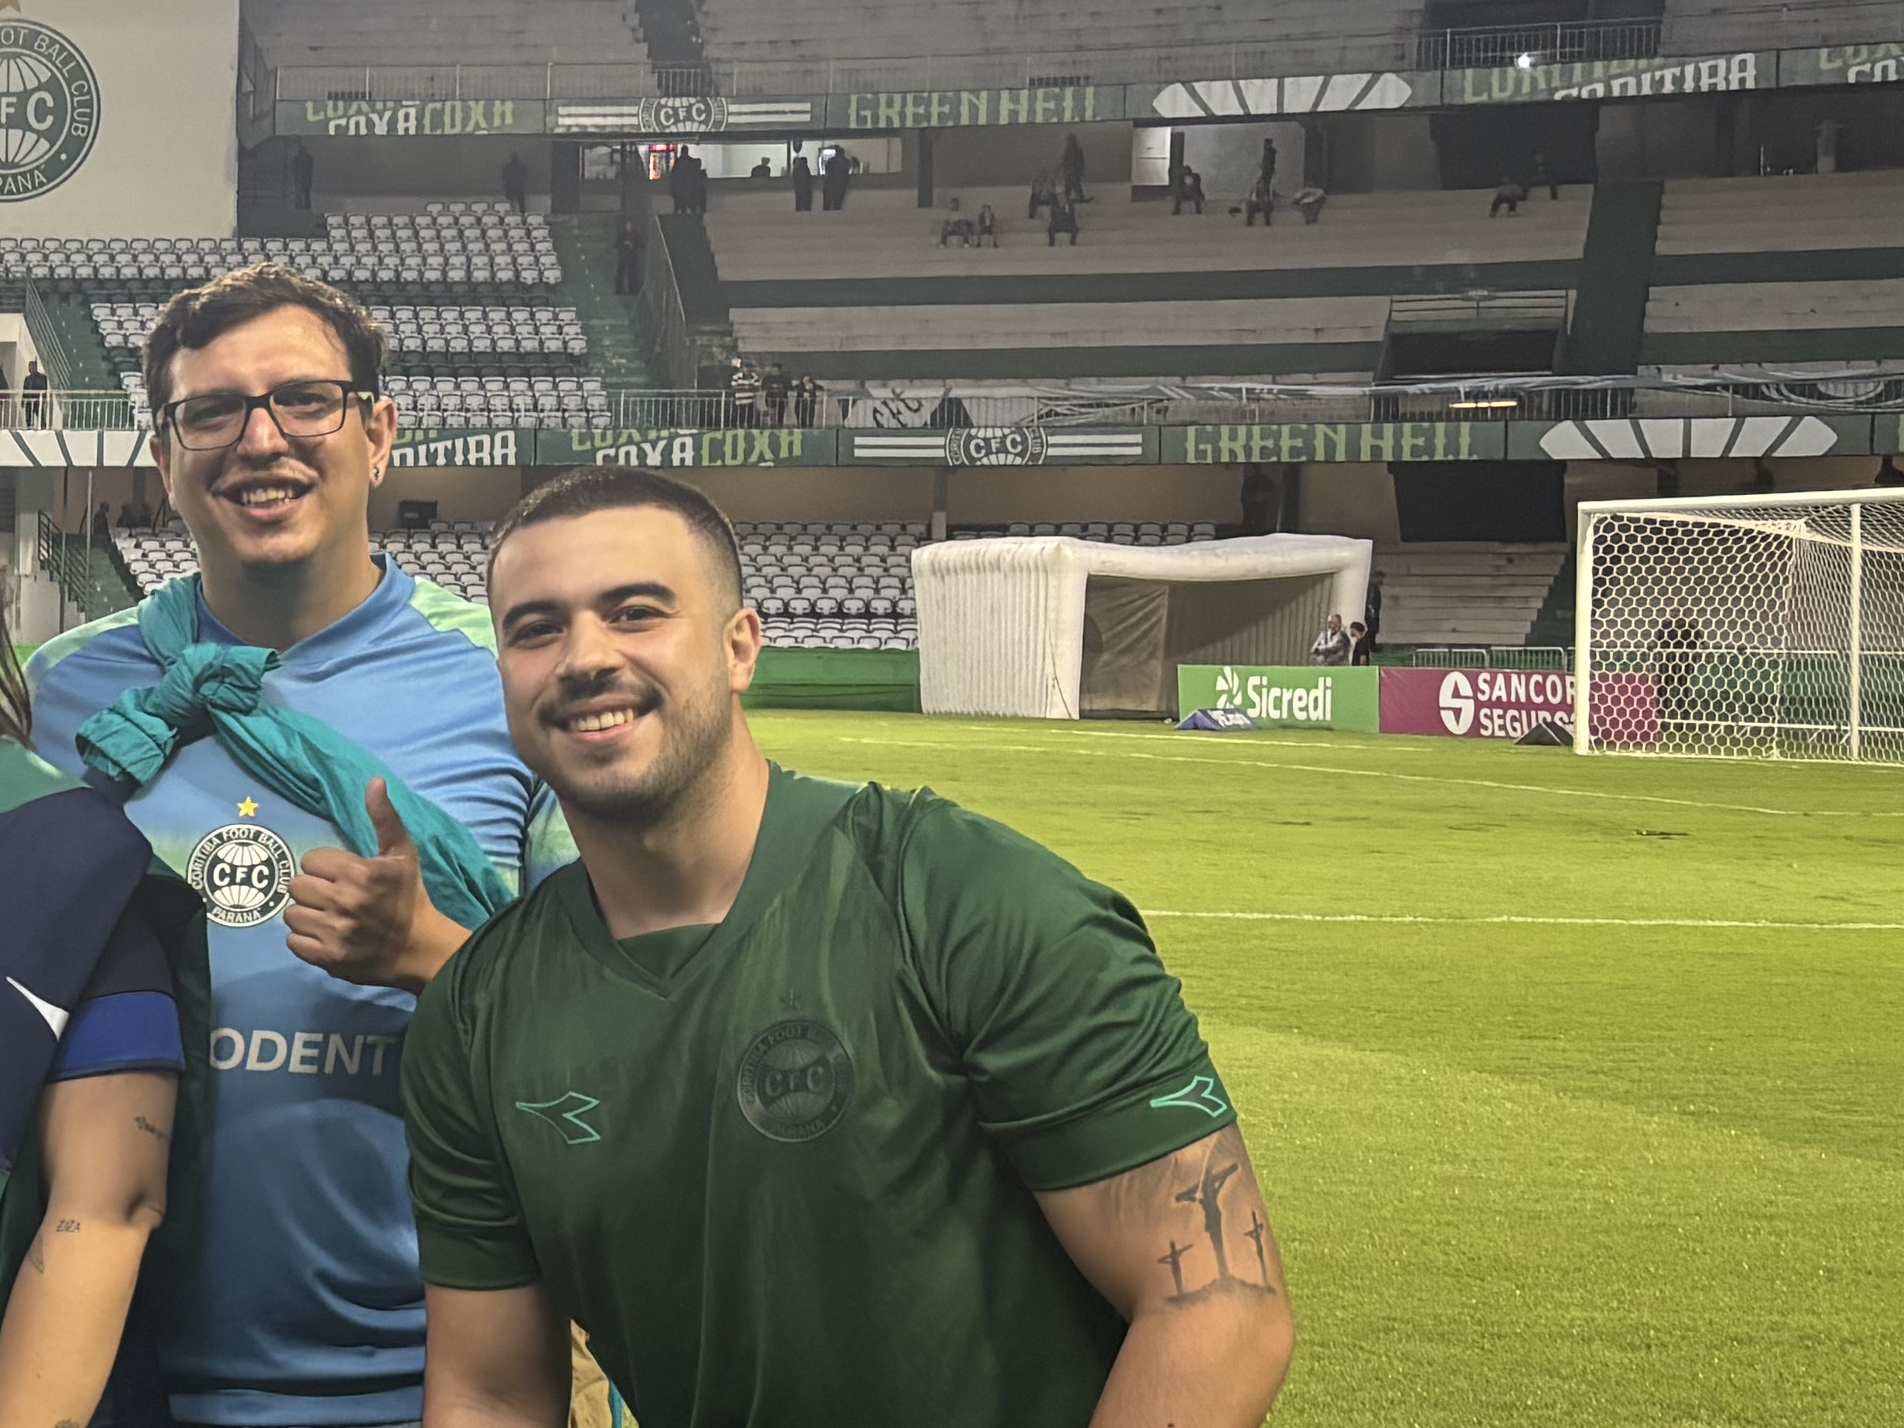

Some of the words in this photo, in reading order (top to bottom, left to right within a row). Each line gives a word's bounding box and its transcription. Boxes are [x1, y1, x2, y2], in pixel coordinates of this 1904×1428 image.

[33, 35, 77, 78] BALL
[71, 79, 92, 138] CLUB
[848, 91, 988, 130] GREEN
[999, 86, 1101, 125] HELL
[1185, 424, 1346, 463] GREEN
[1359, 422, 1478, 461] HELL
[1247, 676, 1332, 721] Sicredi
[222, 828, 258, 842] FOOT
[258, 833, 282, 859] BALL
[213, 863, 270, 889] CFC
